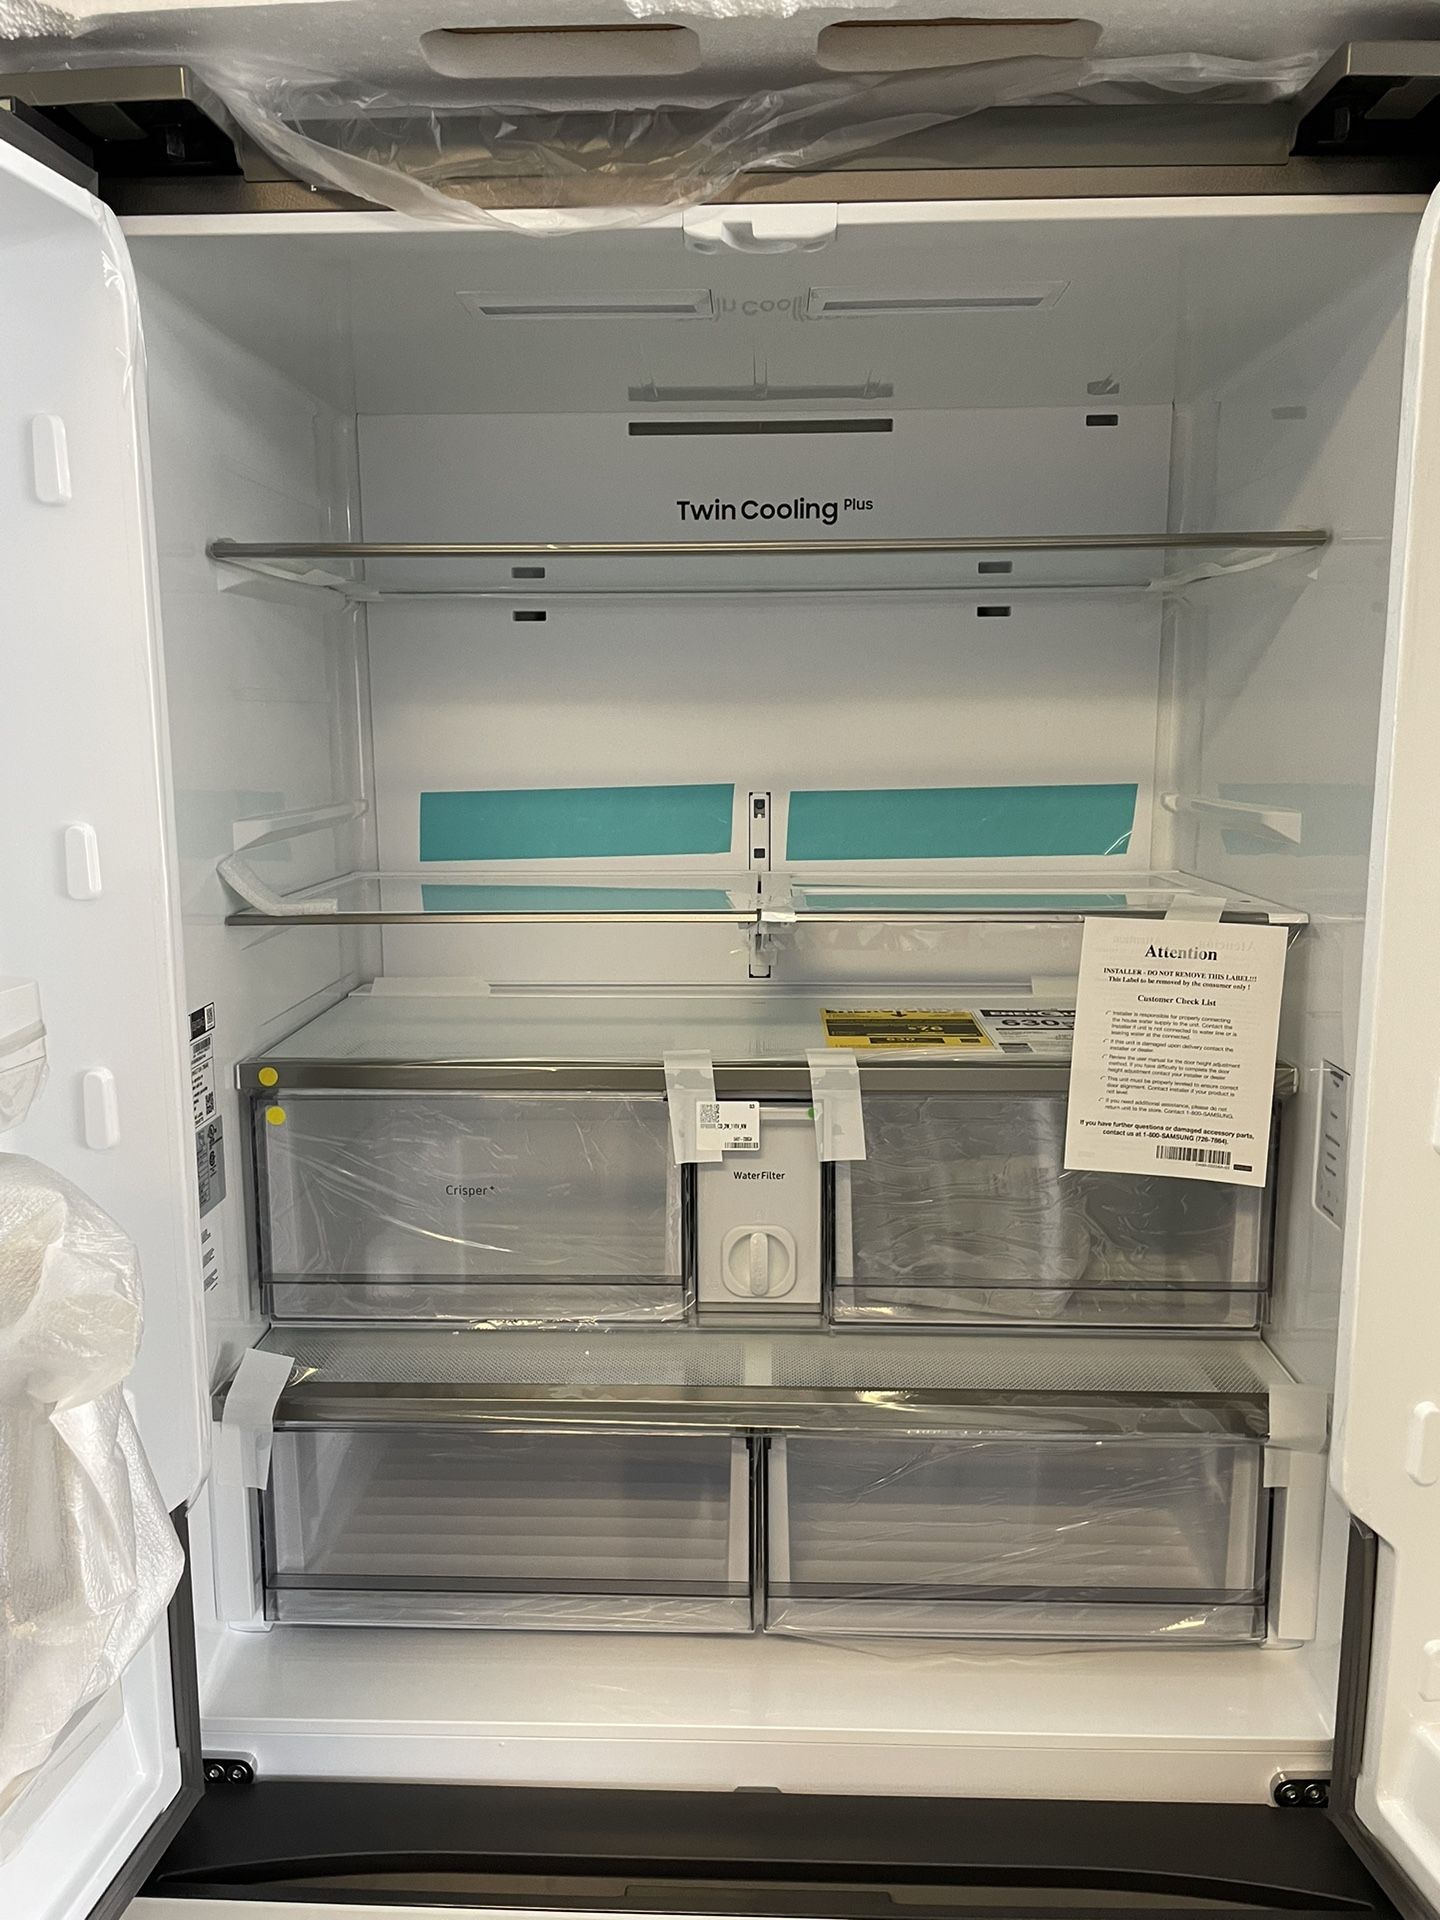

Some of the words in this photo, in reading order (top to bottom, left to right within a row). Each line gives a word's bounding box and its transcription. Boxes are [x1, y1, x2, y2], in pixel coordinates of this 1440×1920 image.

[677, 499, 736, 520] Twin
[741, 497, 837, 525] Cooling
[844, 498, 873, 510] Plus
[1144, 944, 1217, 960] Attention
[1103, 967, 1142, 975] INSTALLER
[1175, 997, 1199, 1005] Check
